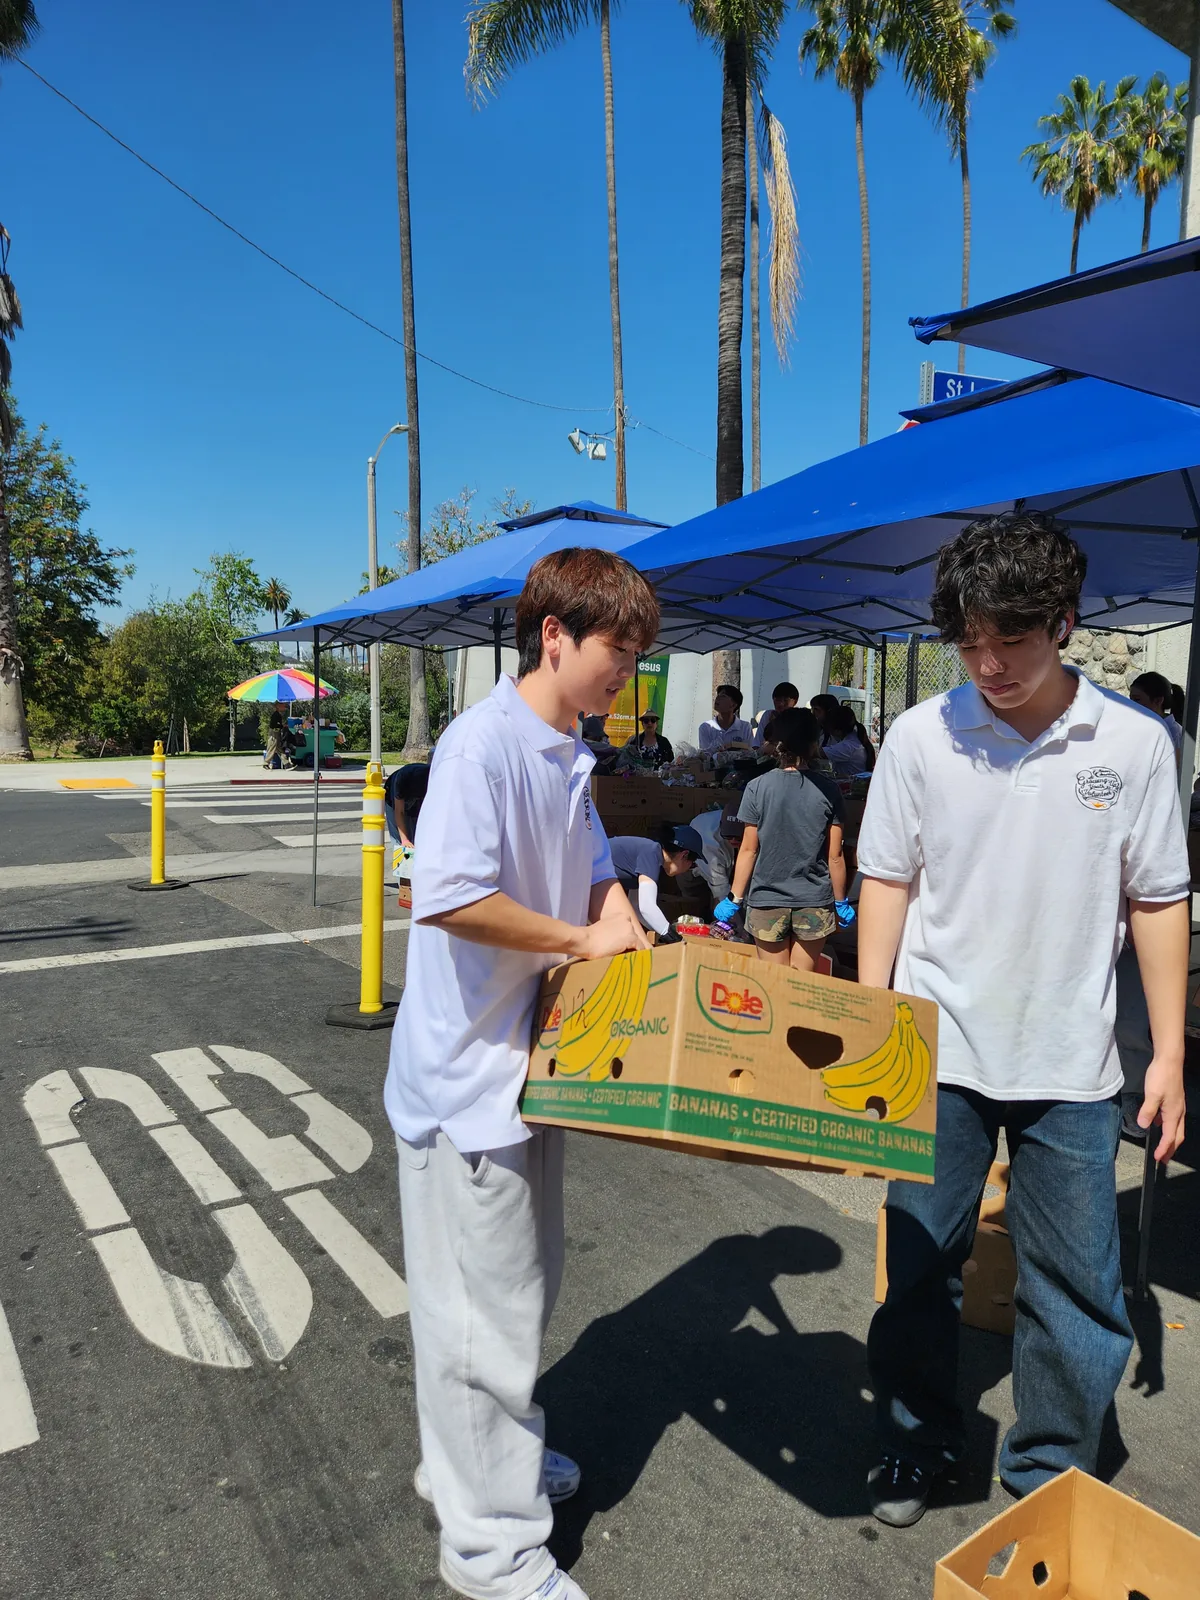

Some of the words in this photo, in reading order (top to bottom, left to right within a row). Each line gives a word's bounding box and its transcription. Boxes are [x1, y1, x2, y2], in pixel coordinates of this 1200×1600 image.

[946, 378, 963, 399] St
[639, 662, 661, 673] esus
[711, 982, 763, 1015] Dole
[610, 1017, 669, 1038] ORGANIC
[592, 1088, 626, 1106] CERTIFIED
[626, 1089, 662, 1109] ORGANIC
[669, 1093, 739, 1121] BANANAS
[752, 1107, 818, 1135] CERTIFIED
[820, 1120, 876, 1145] ORGANIC
[878, 1130, 933, 1157] BANANAS
